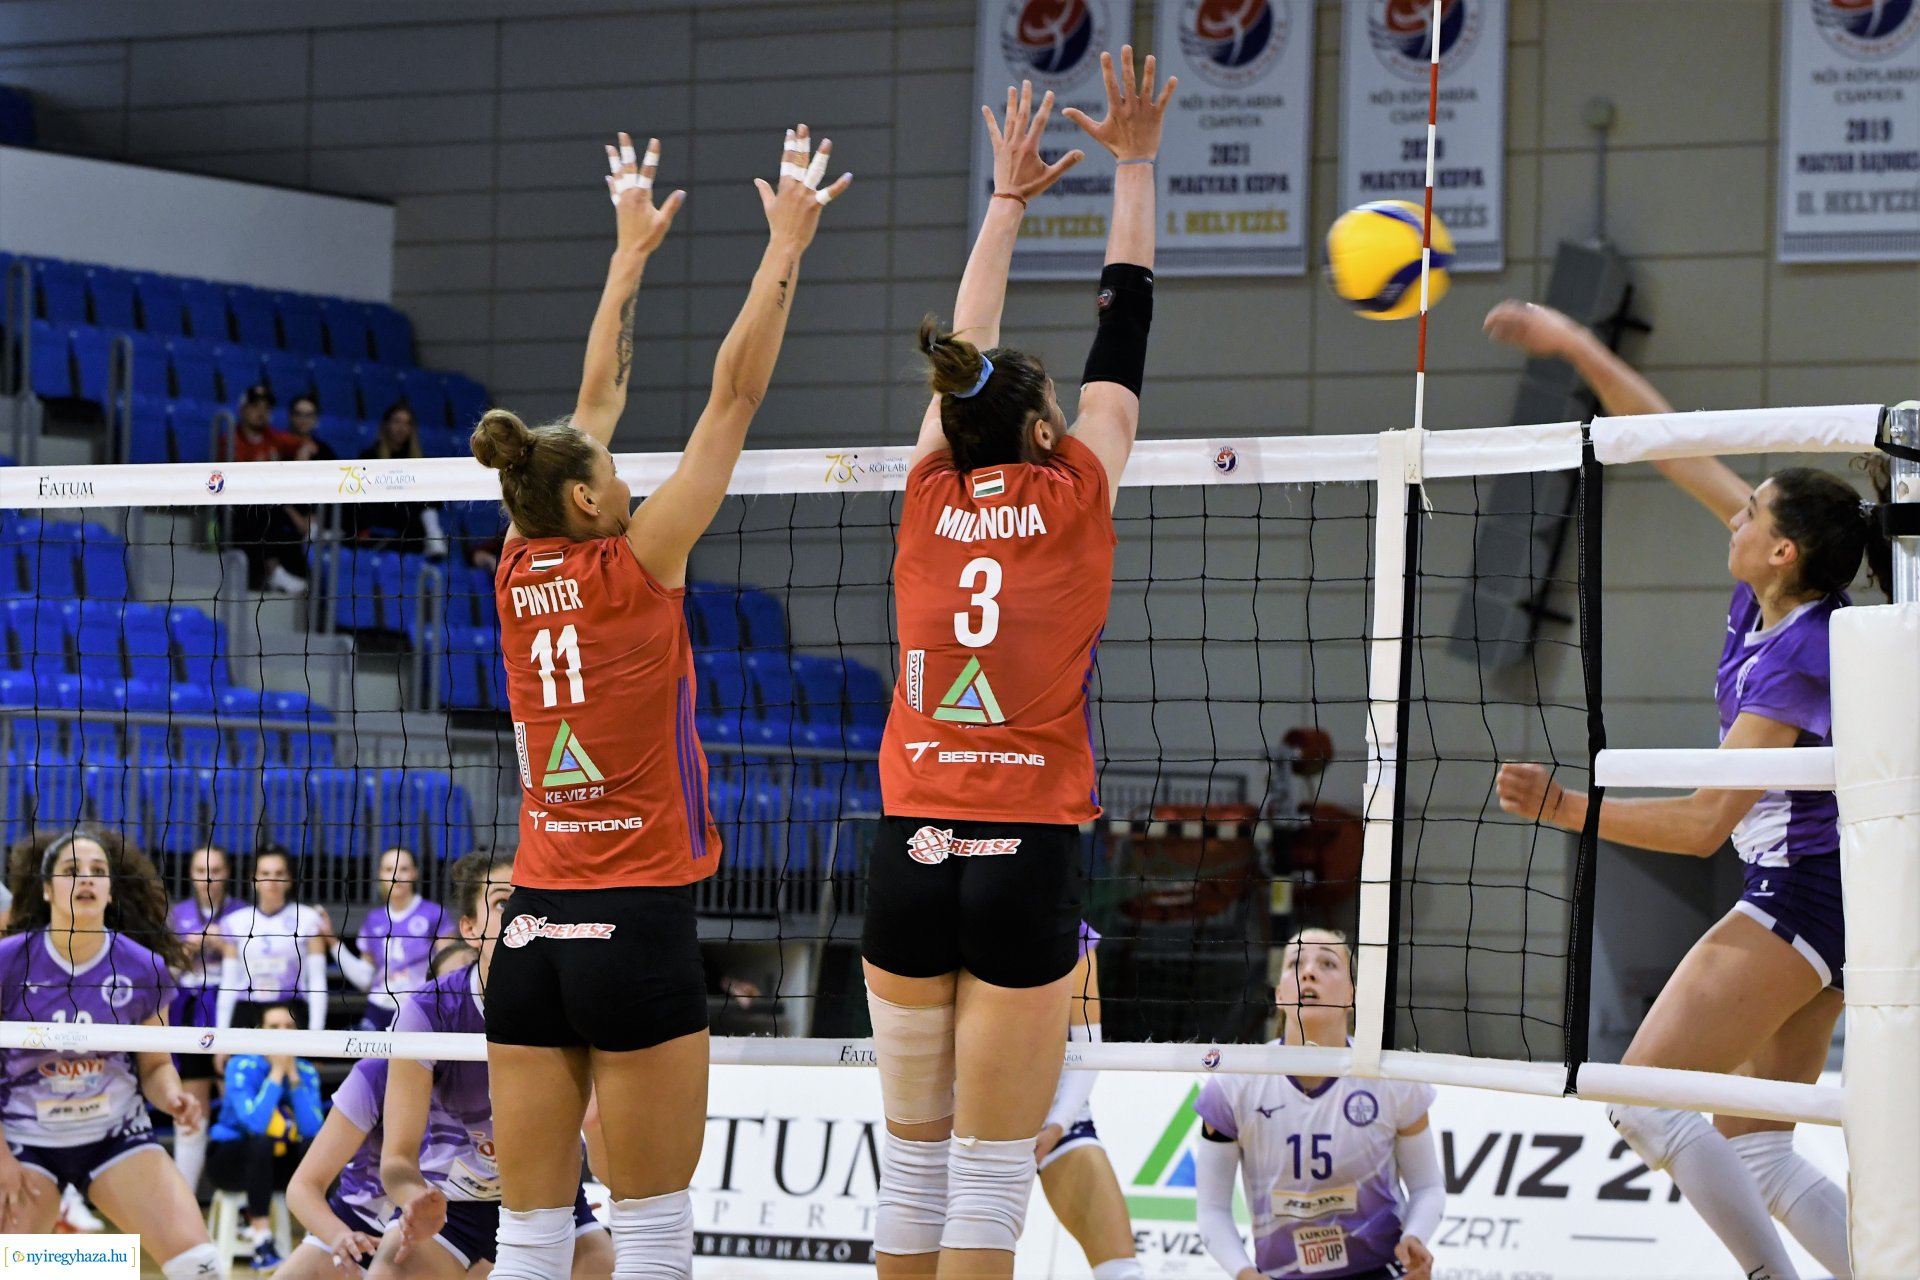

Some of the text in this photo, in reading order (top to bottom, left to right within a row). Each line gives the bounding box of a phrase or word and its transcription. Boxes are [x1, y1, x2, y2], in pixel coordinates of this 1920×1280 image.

[1847, 118, 1892, 142] 2019
[1210, 143, 1250, 166] 2021
[1169, 173, 1289, 195] MAGYAR KUPA
[511, 575, 583, 618] PINTÉR
[954, 557, 1002, 648] 3
[531, 624, 585, 708] 11
[938, 751, 1045, 767] BESTRONG
[545, 785, 605, 804] KE-VIZ 21
[545, 817, 643, 833] BESTRONG
[840, 1045, 877, 1062] FATU
[1286, 1134, 1332, 1180] 15
[1441, 1131, 1687, 1204] VIZ 2
[1134, 1231, 1204, 1255] E-VIZ
[1438, 1215, 1520, 1250] ZRT.
